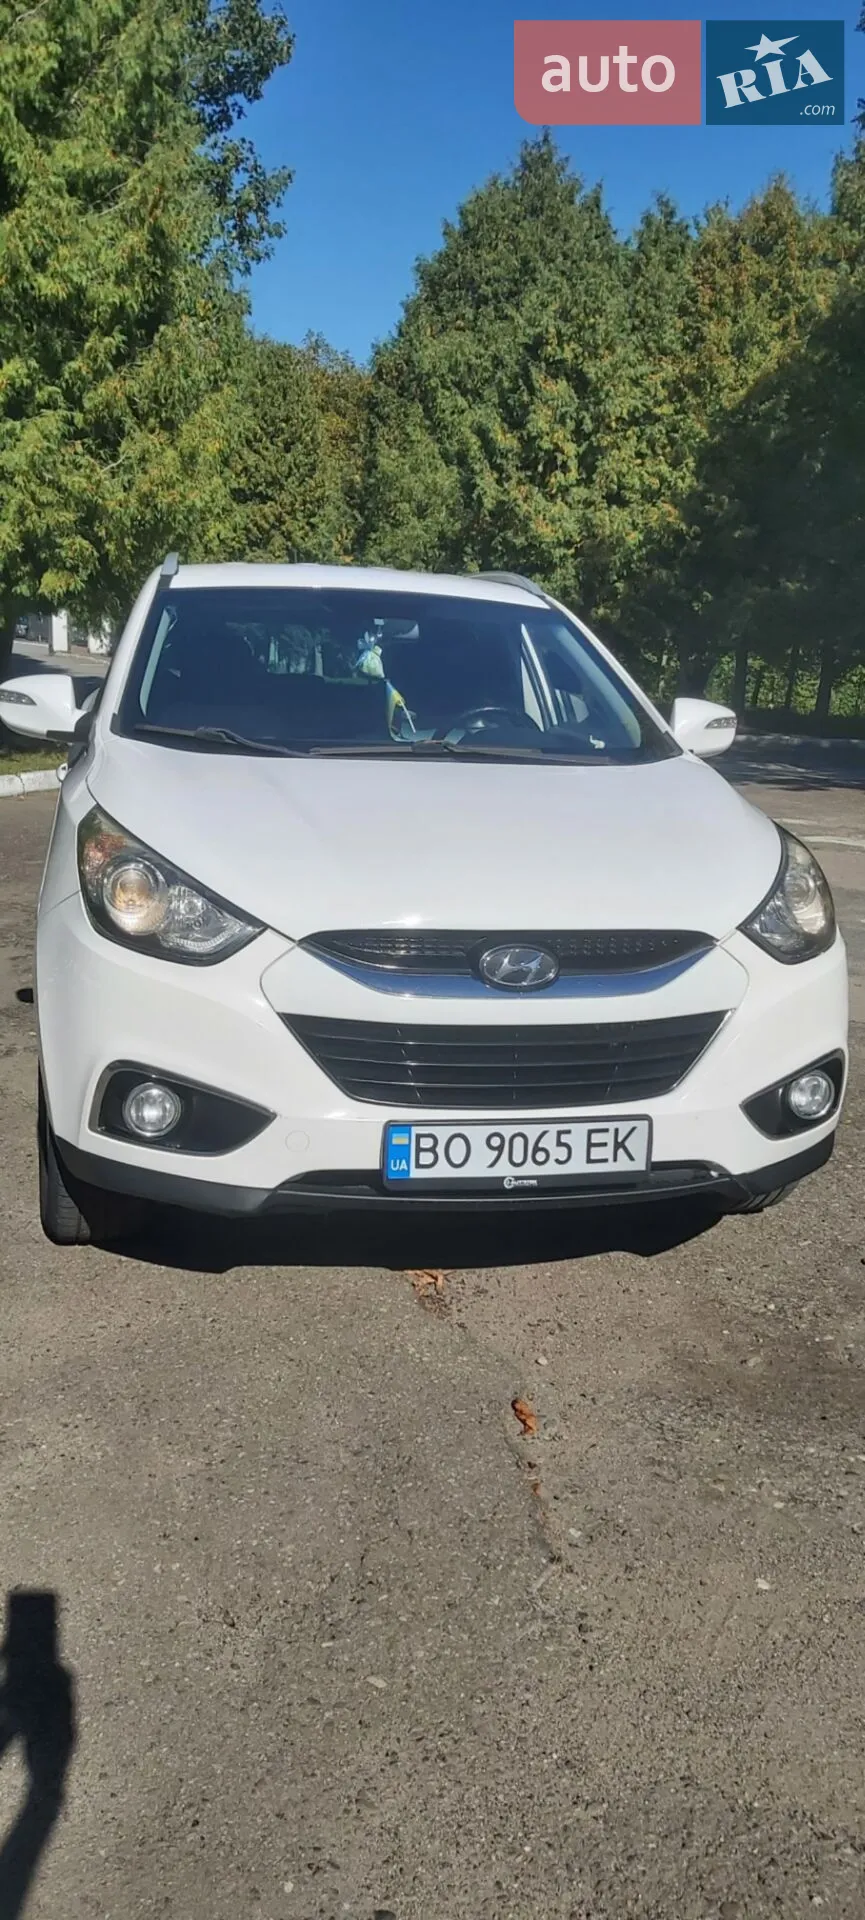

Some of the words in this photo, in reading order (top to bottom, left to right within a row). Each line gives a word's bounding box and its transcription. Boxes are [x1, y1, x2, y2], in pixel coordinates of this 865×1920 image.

[414, 1132, 472, 1169] BO
[485, 1129, 573, 1168] 9065
[585, 1126, 637, 1164] EK
[391, 1160, 408, 1171] UA
